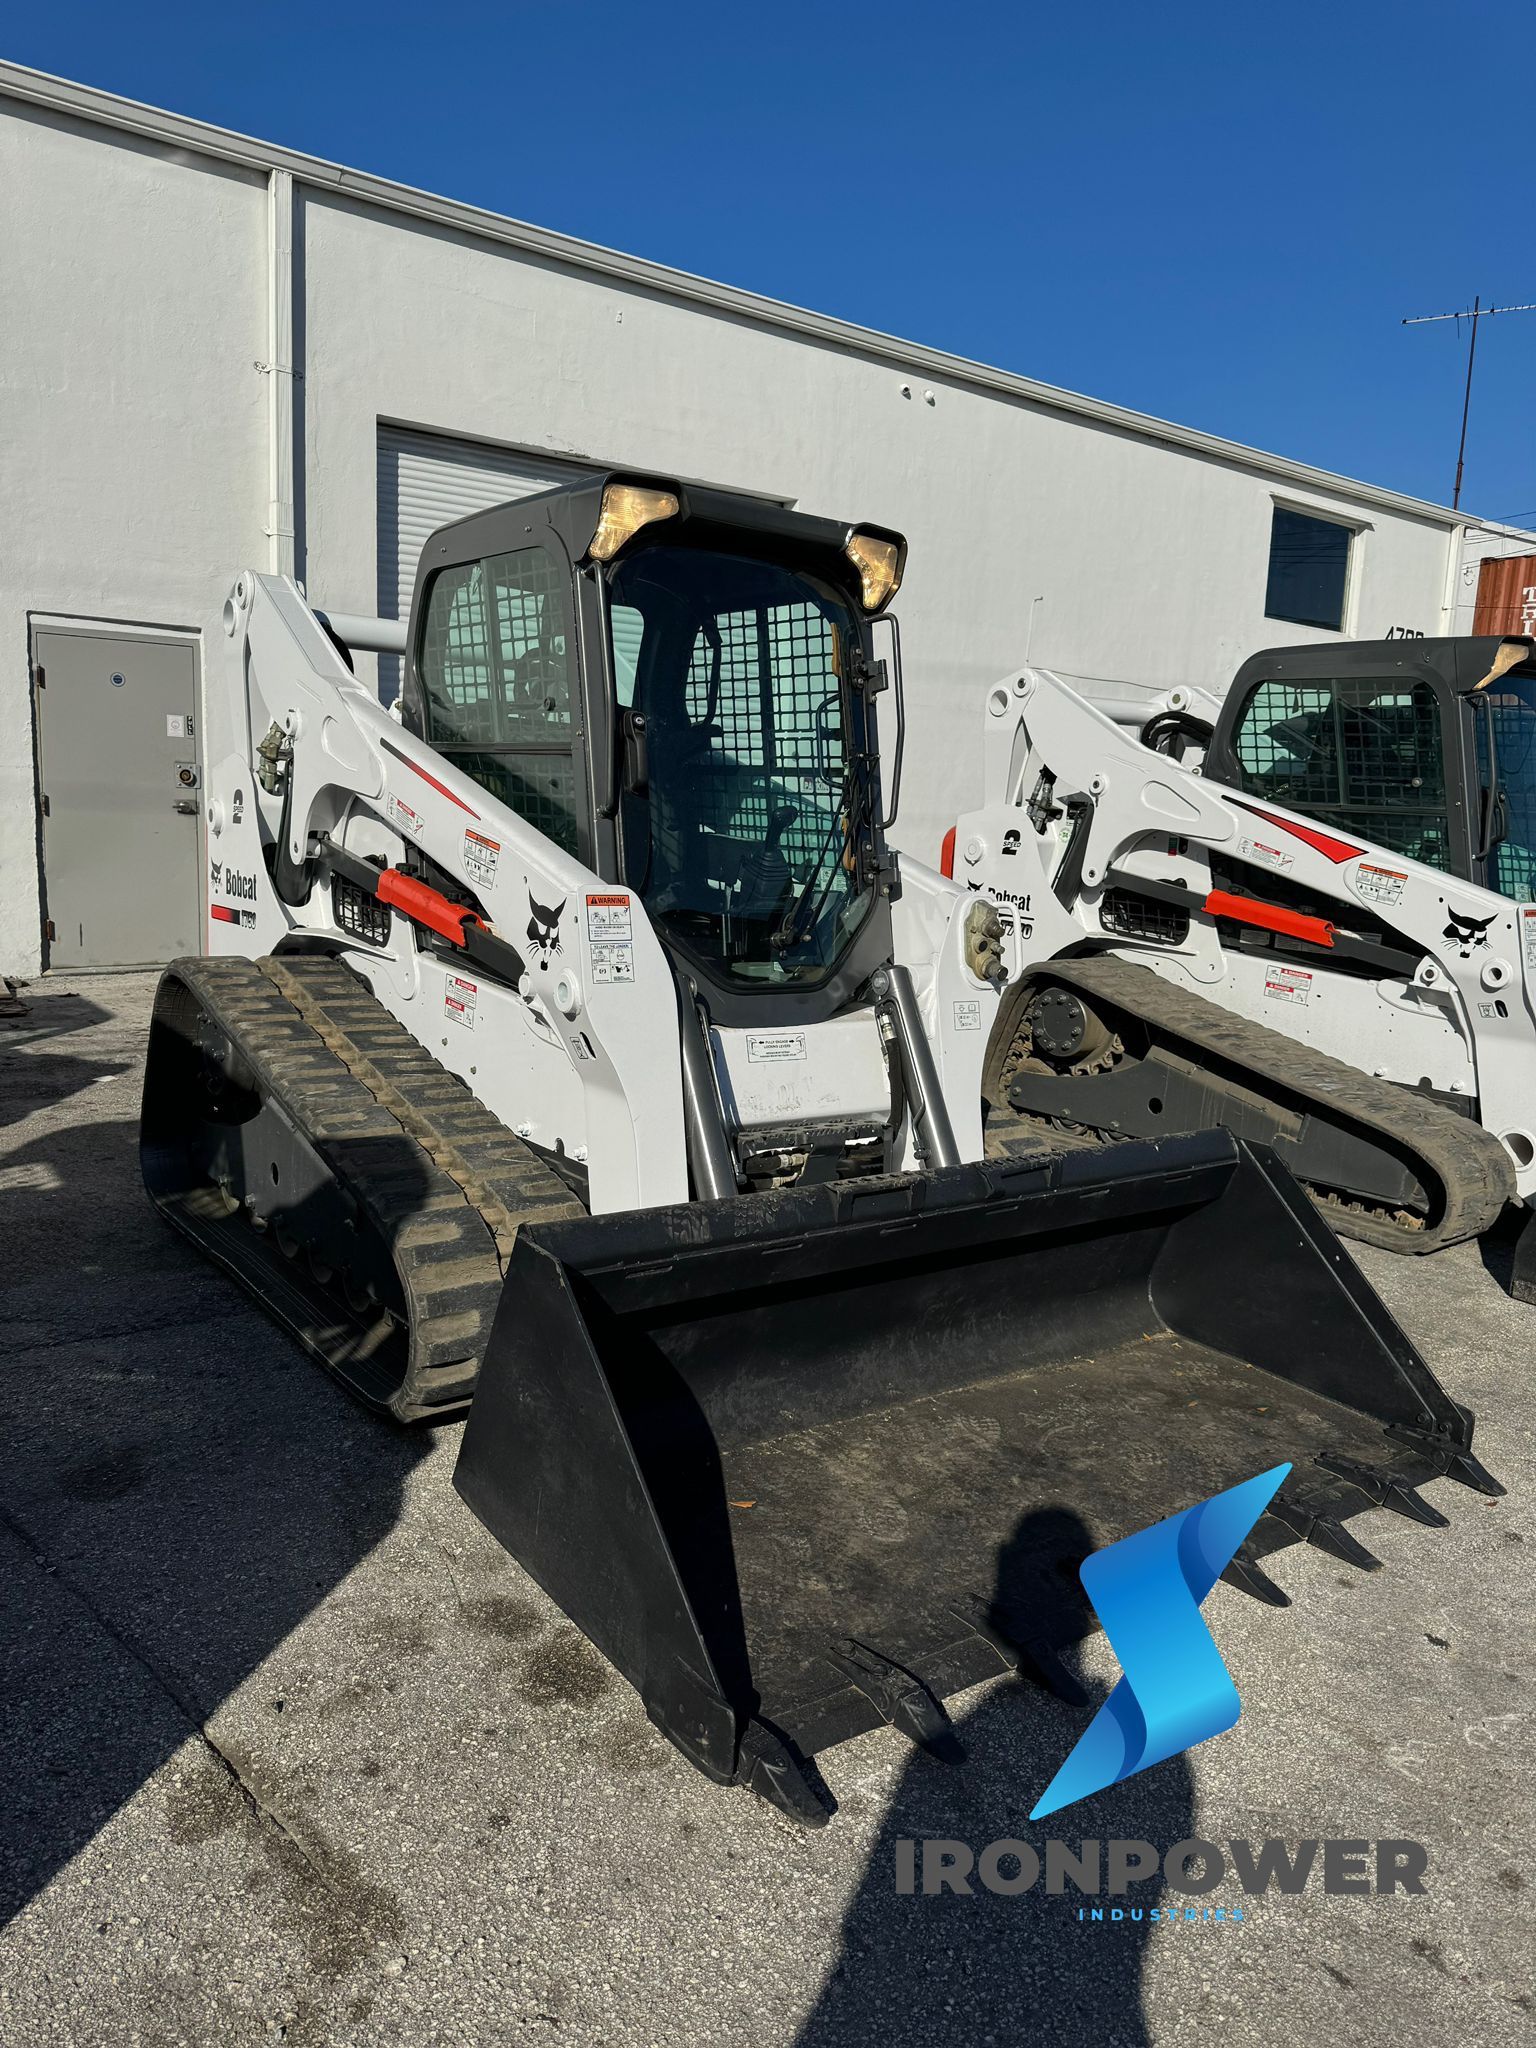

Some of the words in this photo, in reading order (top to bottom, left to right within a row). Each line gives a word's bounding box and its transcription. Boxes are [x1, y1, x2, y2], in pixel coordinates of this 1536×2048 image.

[1001, 829, 1021, 856] 2
[1003, 840, 1022, 849] SPEED
[225, 867, 258, 901] Bobcat
[597, 896, 626, 905] WARNING
